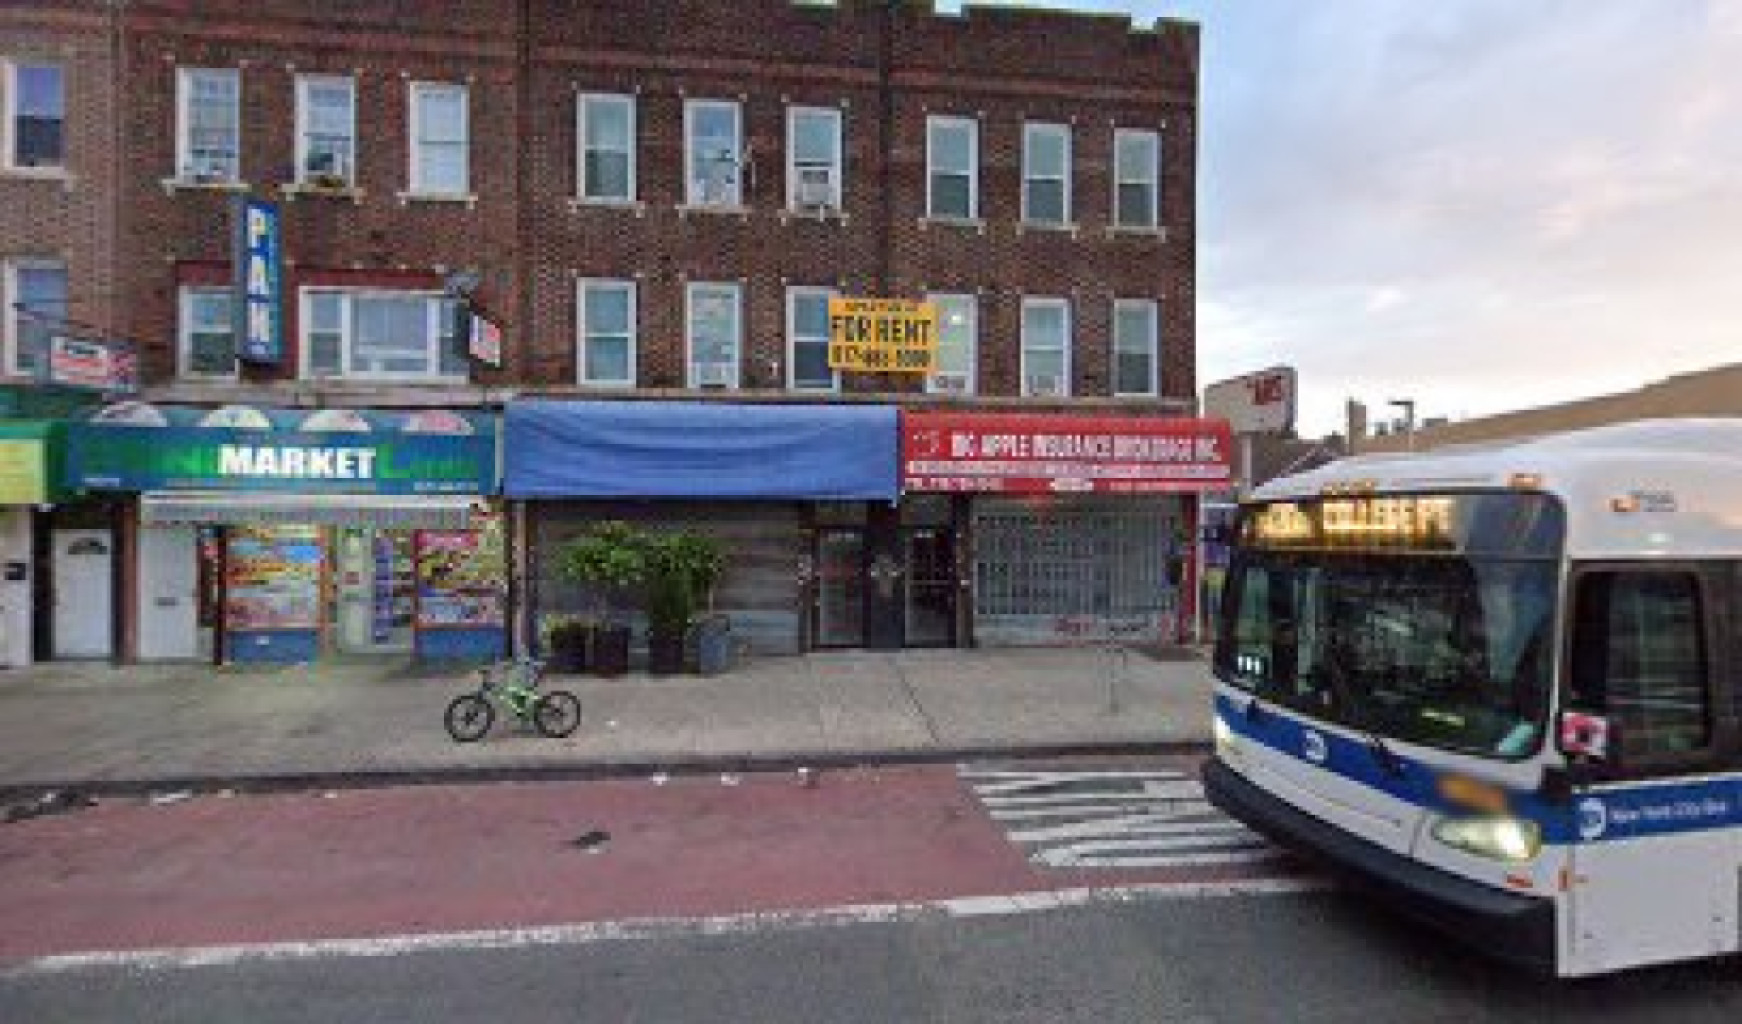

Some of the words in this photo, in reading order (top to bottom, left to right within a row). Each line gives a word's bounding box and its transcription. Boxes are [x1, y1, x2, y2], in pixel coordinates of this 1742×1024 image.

[831, 315, 872, 342] FOR
[875, 316, 931, 346] RENT
[218, 444, 376, 475] MARKET
[981, 434, 1030, 458] APPLE
